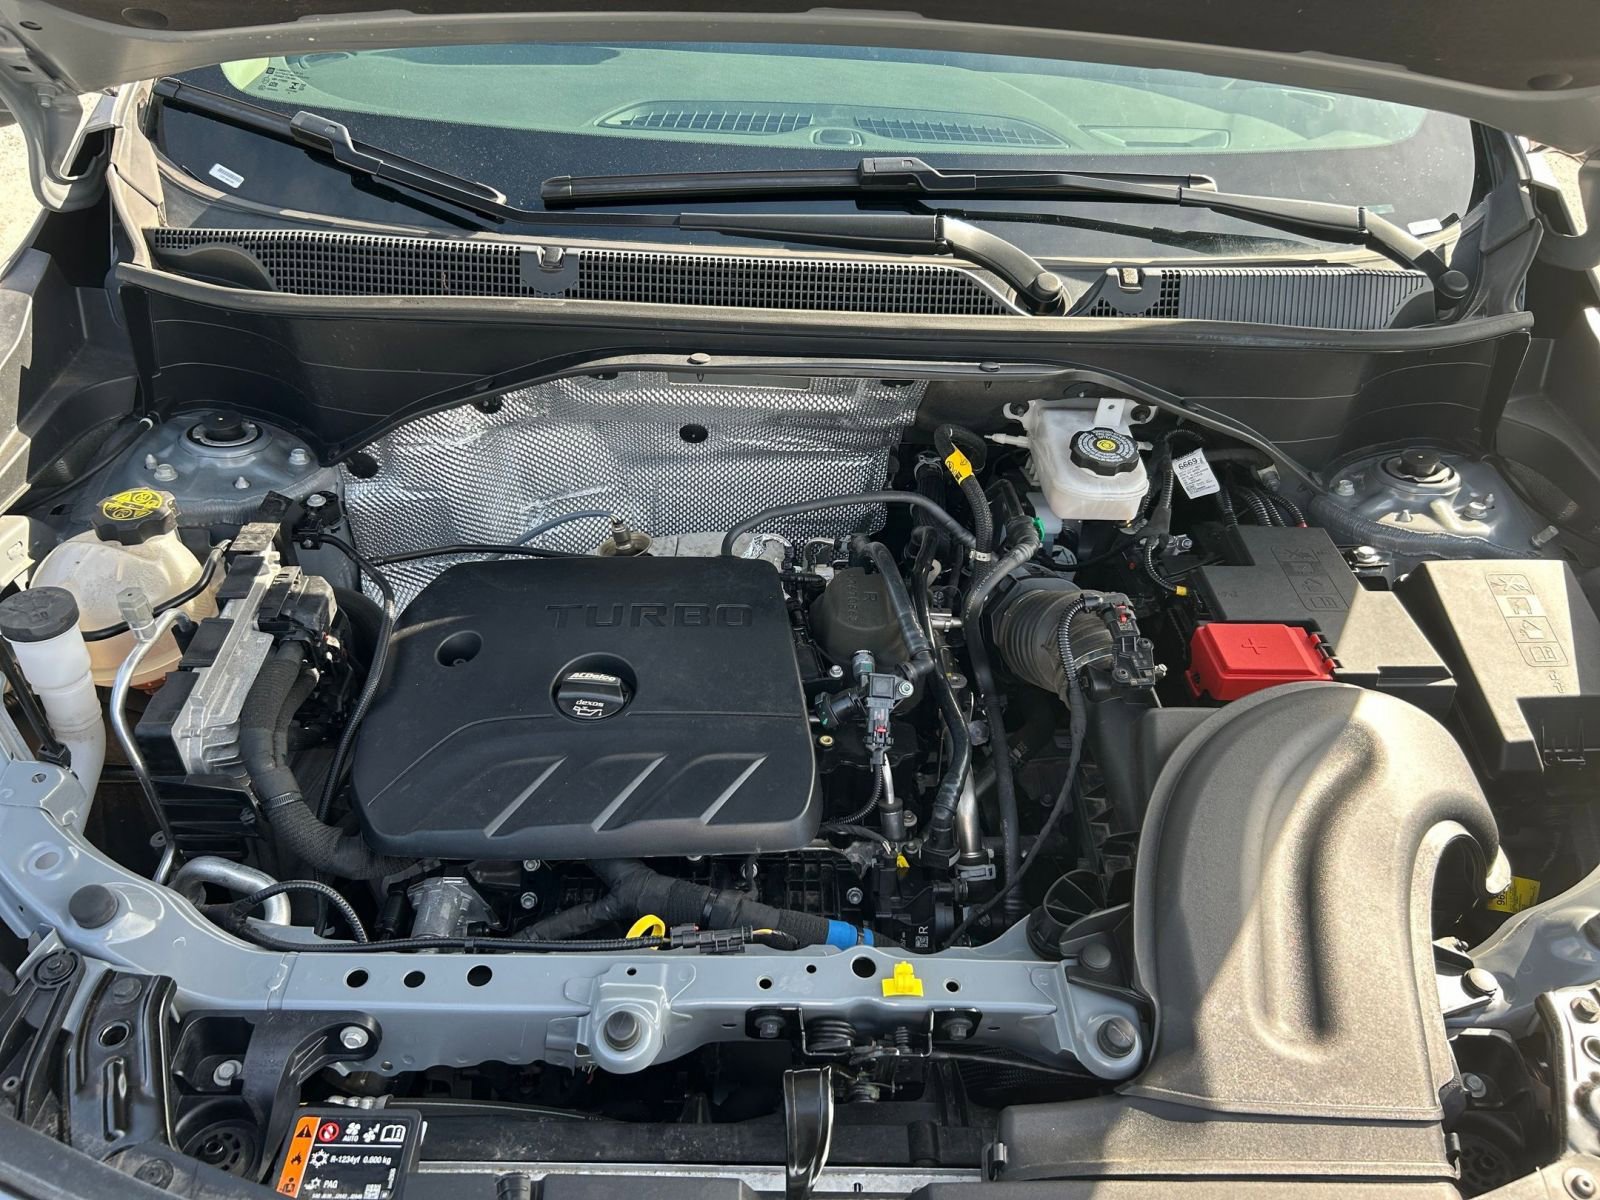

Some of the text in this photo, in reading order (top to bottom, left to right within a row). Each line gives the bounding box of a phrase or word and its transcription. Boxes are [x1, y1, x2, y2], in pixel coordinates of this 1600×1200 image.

[1178, 457, 1198, 470] 6669
[545, 602, 753, 628] TURBO
[567, 672, 616, 682] ACDelco
[575, 699, 604, 707] dexos
[918, 925, 929, 934] R
[329, 1154, 361, 1165] R-1234yf
[382, 1156, 392, 1166] kg
[322, 1180, 339, 1189] PAG
